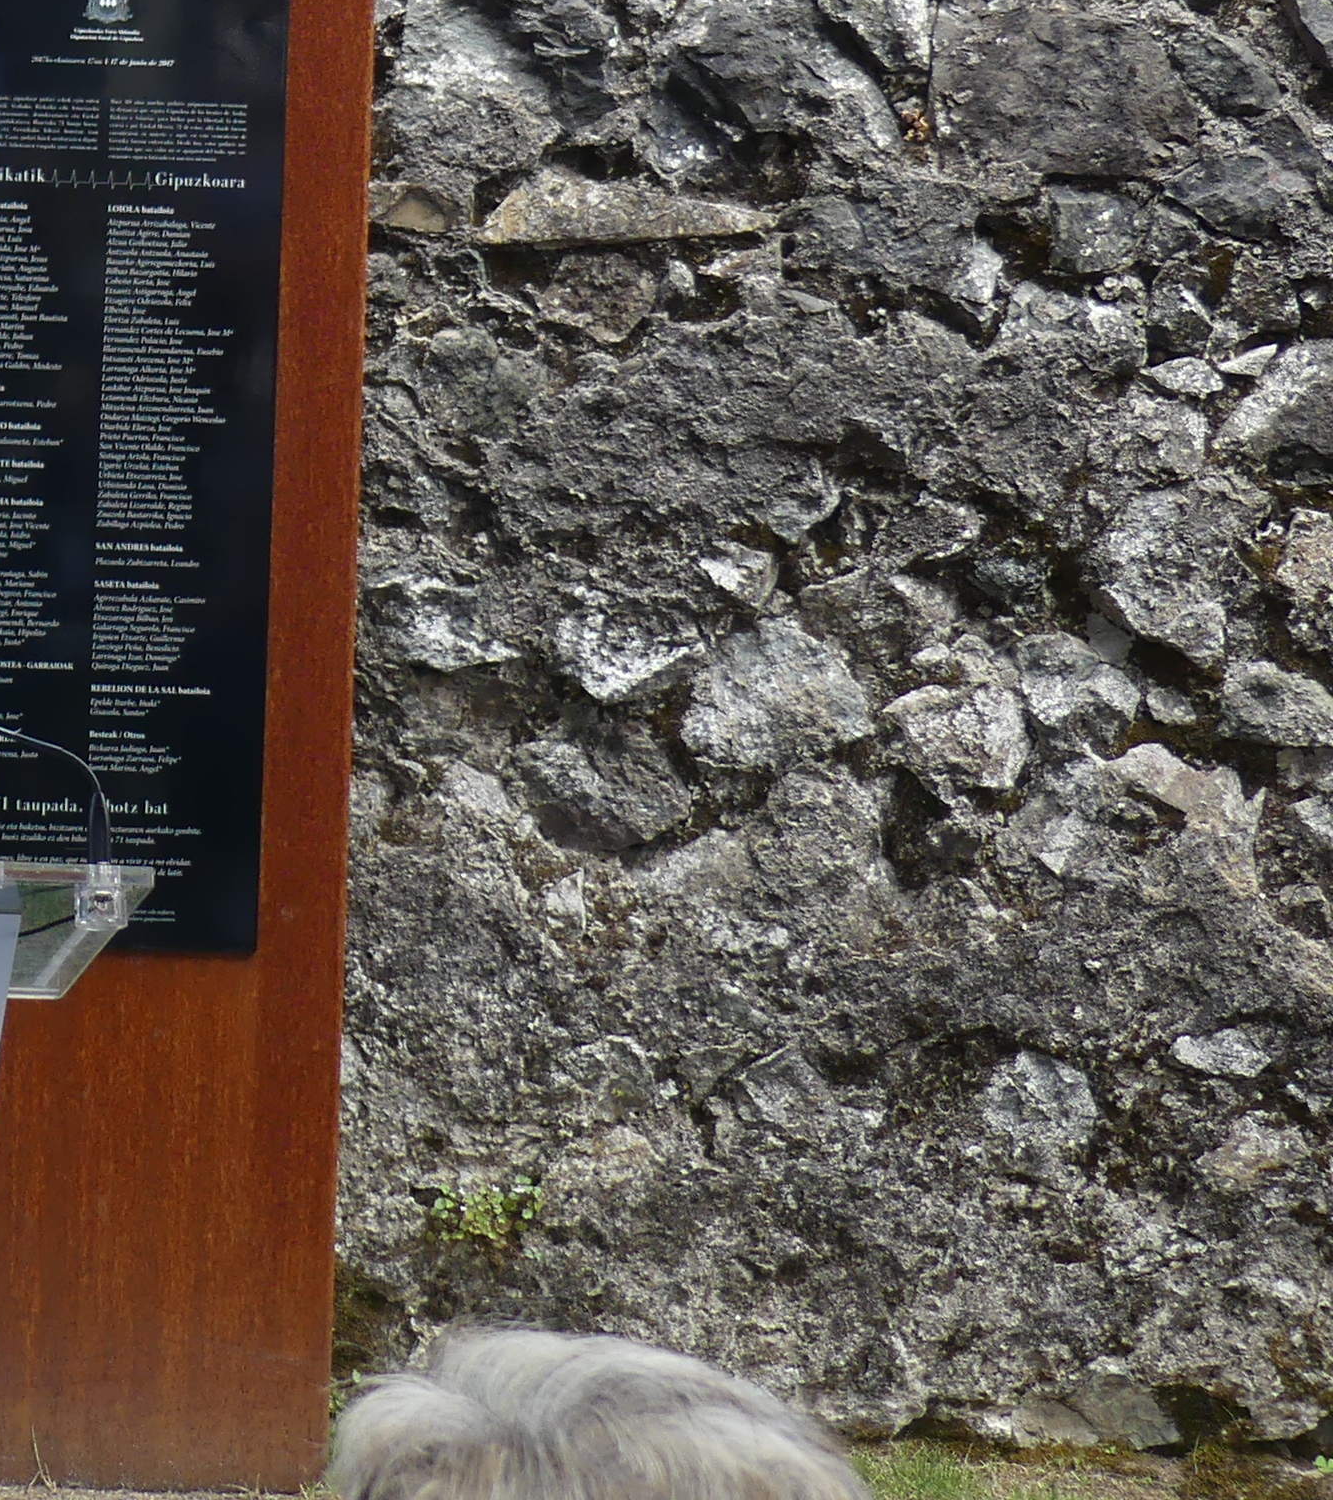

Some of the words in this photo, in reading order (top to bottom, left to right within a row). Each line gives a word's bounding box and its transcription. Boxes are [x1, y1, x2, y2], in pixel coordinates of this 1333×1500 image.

[154, 171, 245, 193] Gipuzkoara
[8, 421, 41, 430] batailoia
[11, 460, 44, 468] batailoia
[10, 497, 43, 506] batailoia
[150, 543, 183, 552] batailoia
[94, 580, 125, 588] SASETA
[178, 687, 210, 695] batailoia
[89, 730, 117, 738] Besteak
[16, 796, 83, 816] taupada.
[144, 800, 168, 814] bat
